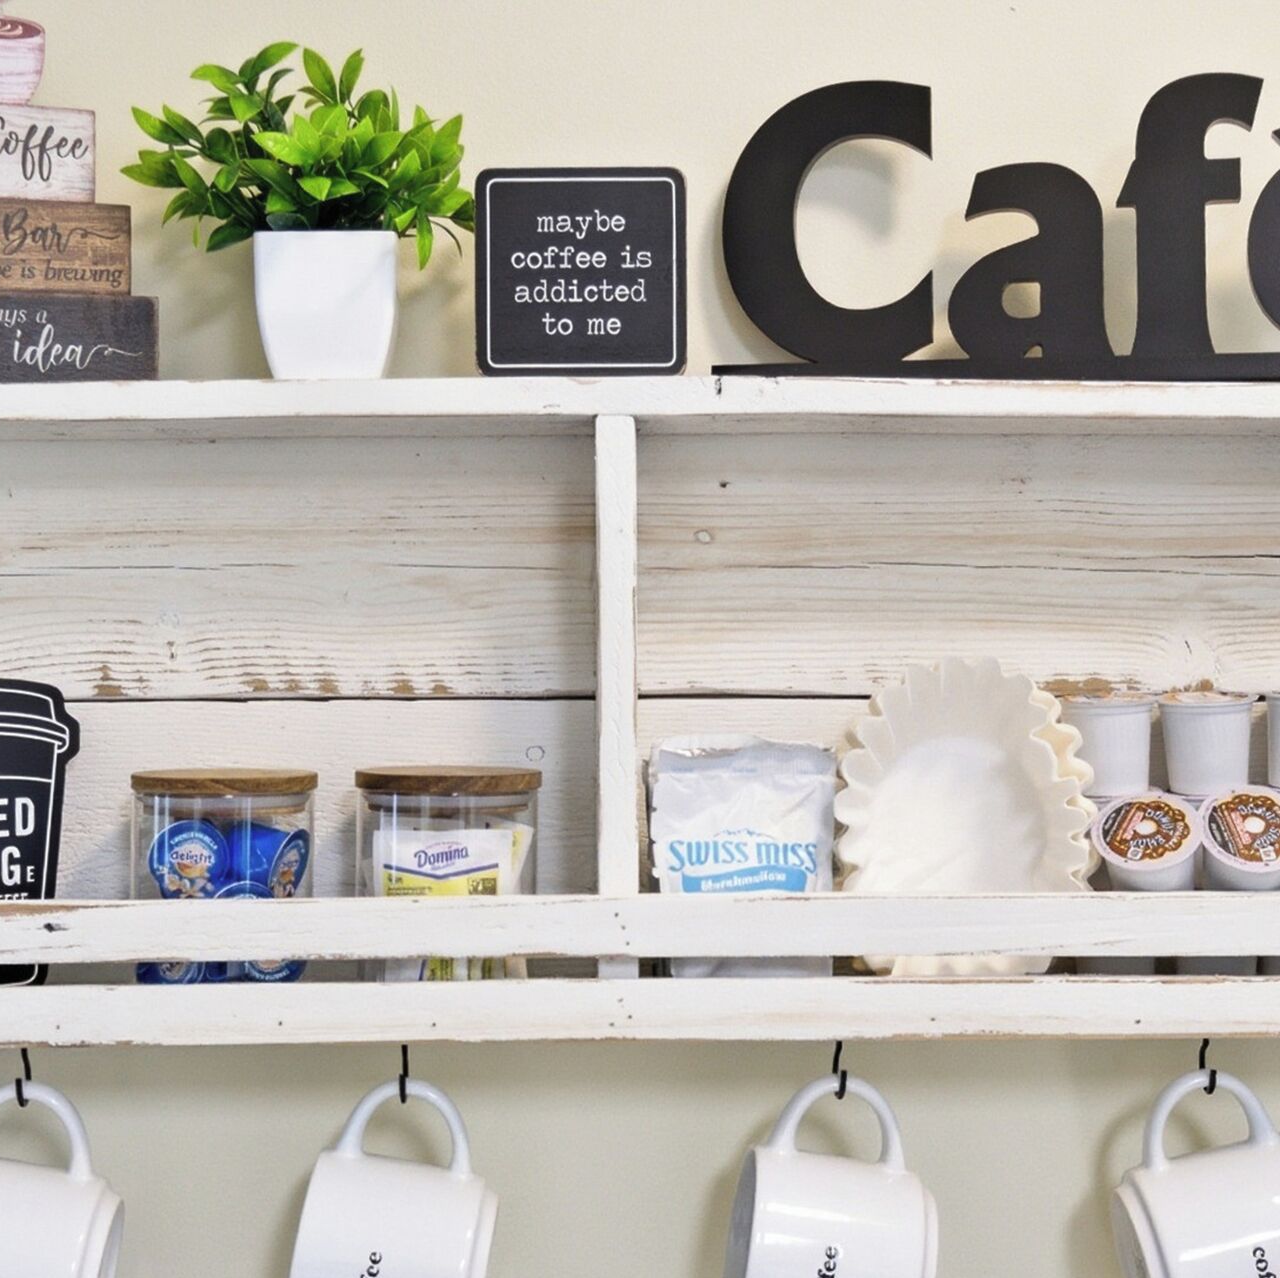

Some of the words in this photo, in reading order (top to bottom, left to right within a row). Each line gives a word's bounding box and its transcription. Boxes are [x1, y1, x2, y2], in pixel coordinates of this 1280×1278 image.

[3, 208, 78, 254] Bar
[536, 209, 626, 239] maybe
[510, 247, 607, 269] coffee
[620, 245, 652, 268] is
[22, 259, 35, 279] is
[44, 259, 123, 288] brewing
[514, 279, 648, 303] addicted
[36, 309, 48, 324] a
[542, 313, 573, 335] to
[587, 317, 622, 335] me
[13, 324, 94, 372] idea
